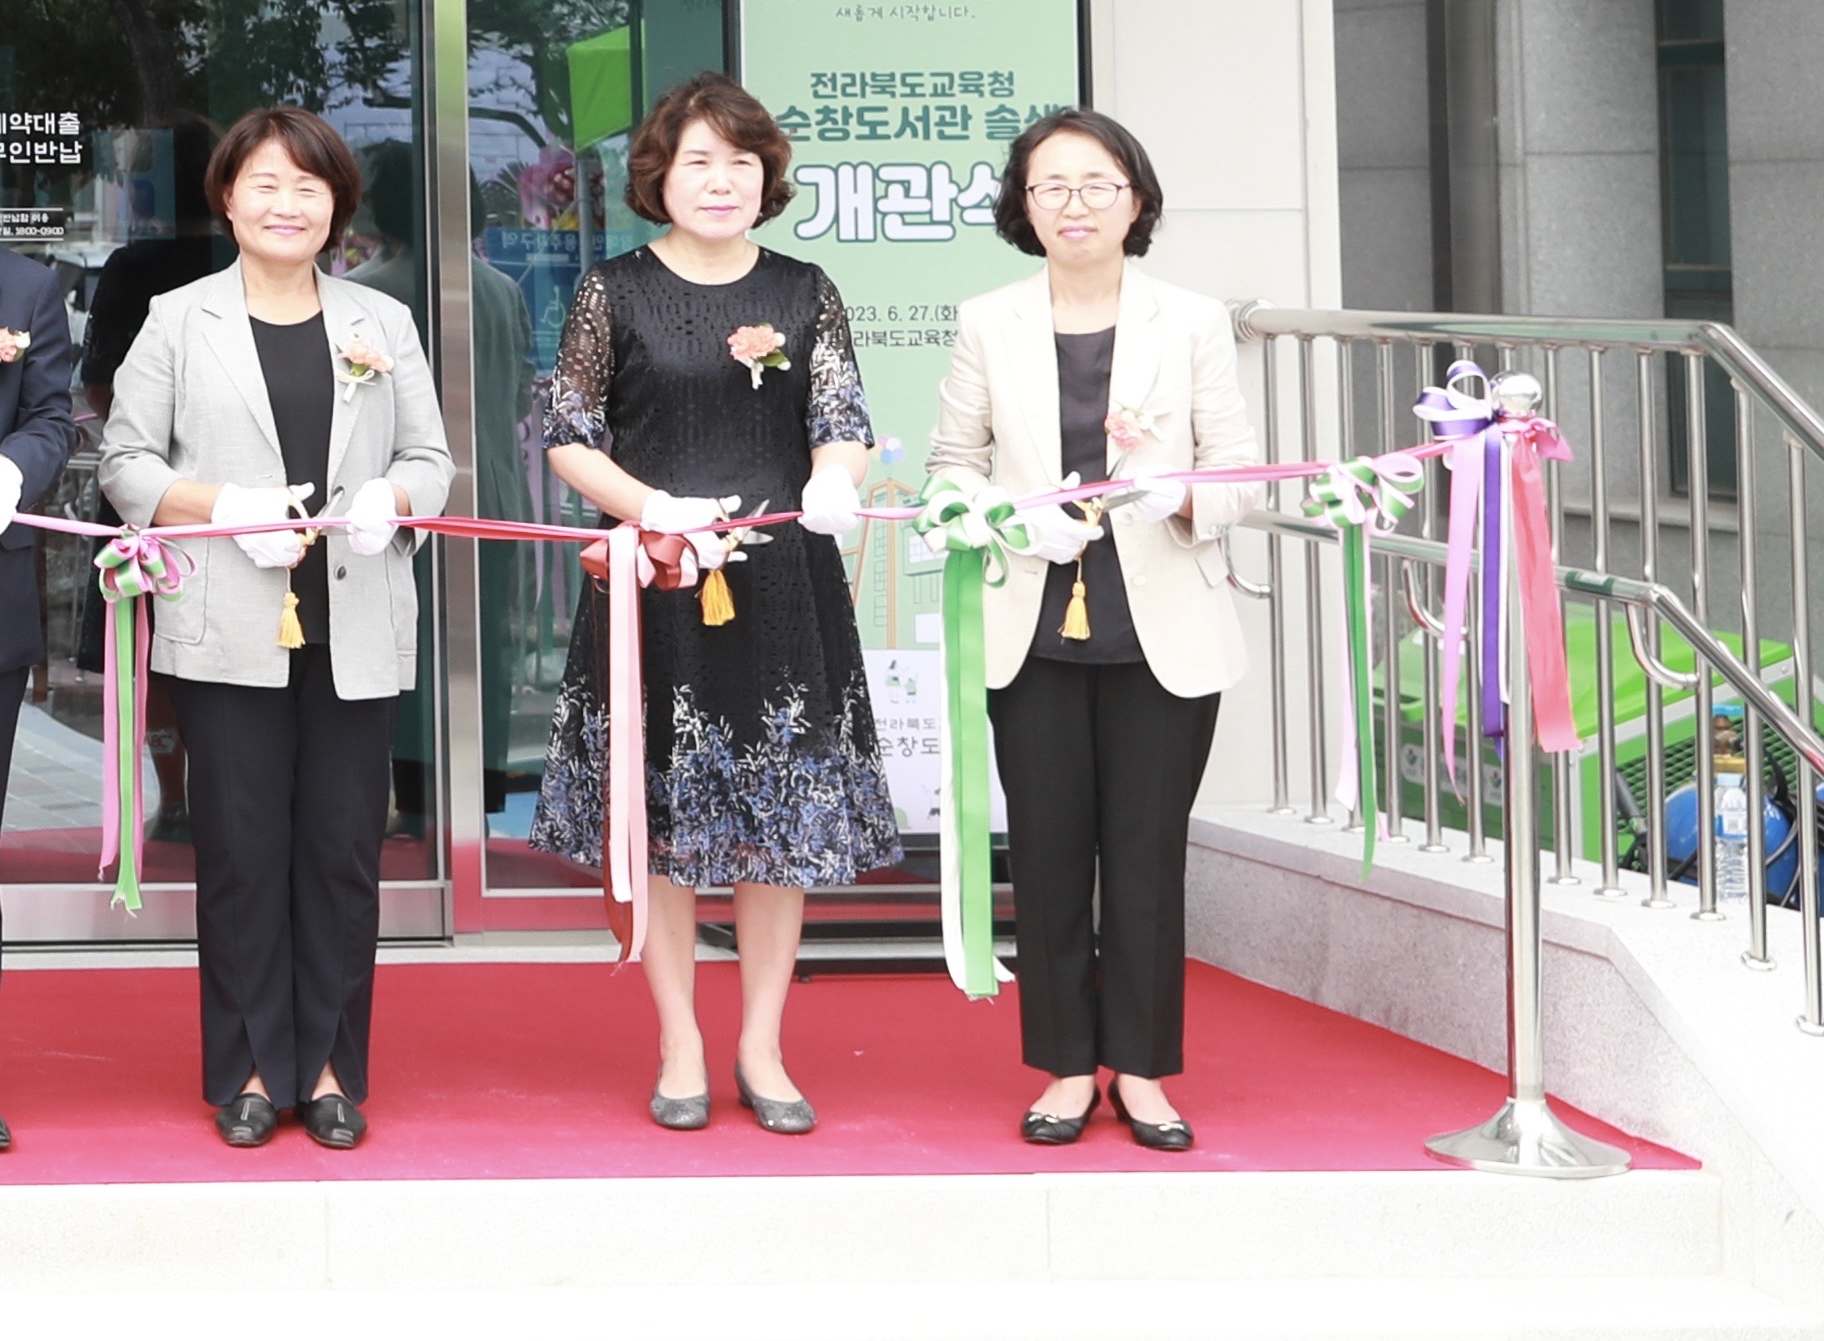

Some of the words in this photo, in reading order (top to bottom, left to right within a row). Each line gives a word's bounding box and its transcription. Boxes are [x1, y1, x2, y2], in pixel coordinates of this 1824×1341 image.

[836, 4, 883, 22] 새롭게
[890, 5, 976, 22] 시작합니다.
[810, 70, 1015, 99] 전라북도교육청
[776, 105, 972, 142] 순창도서관
[846, 305, 881, 321] 023.
[908, 305, 958, 321] 27.(화
[853, 329, 958, 347] 라북도교육청
[875, 717, 936, 731] 전라북도
[879, 736, 940, 757] 순창도
